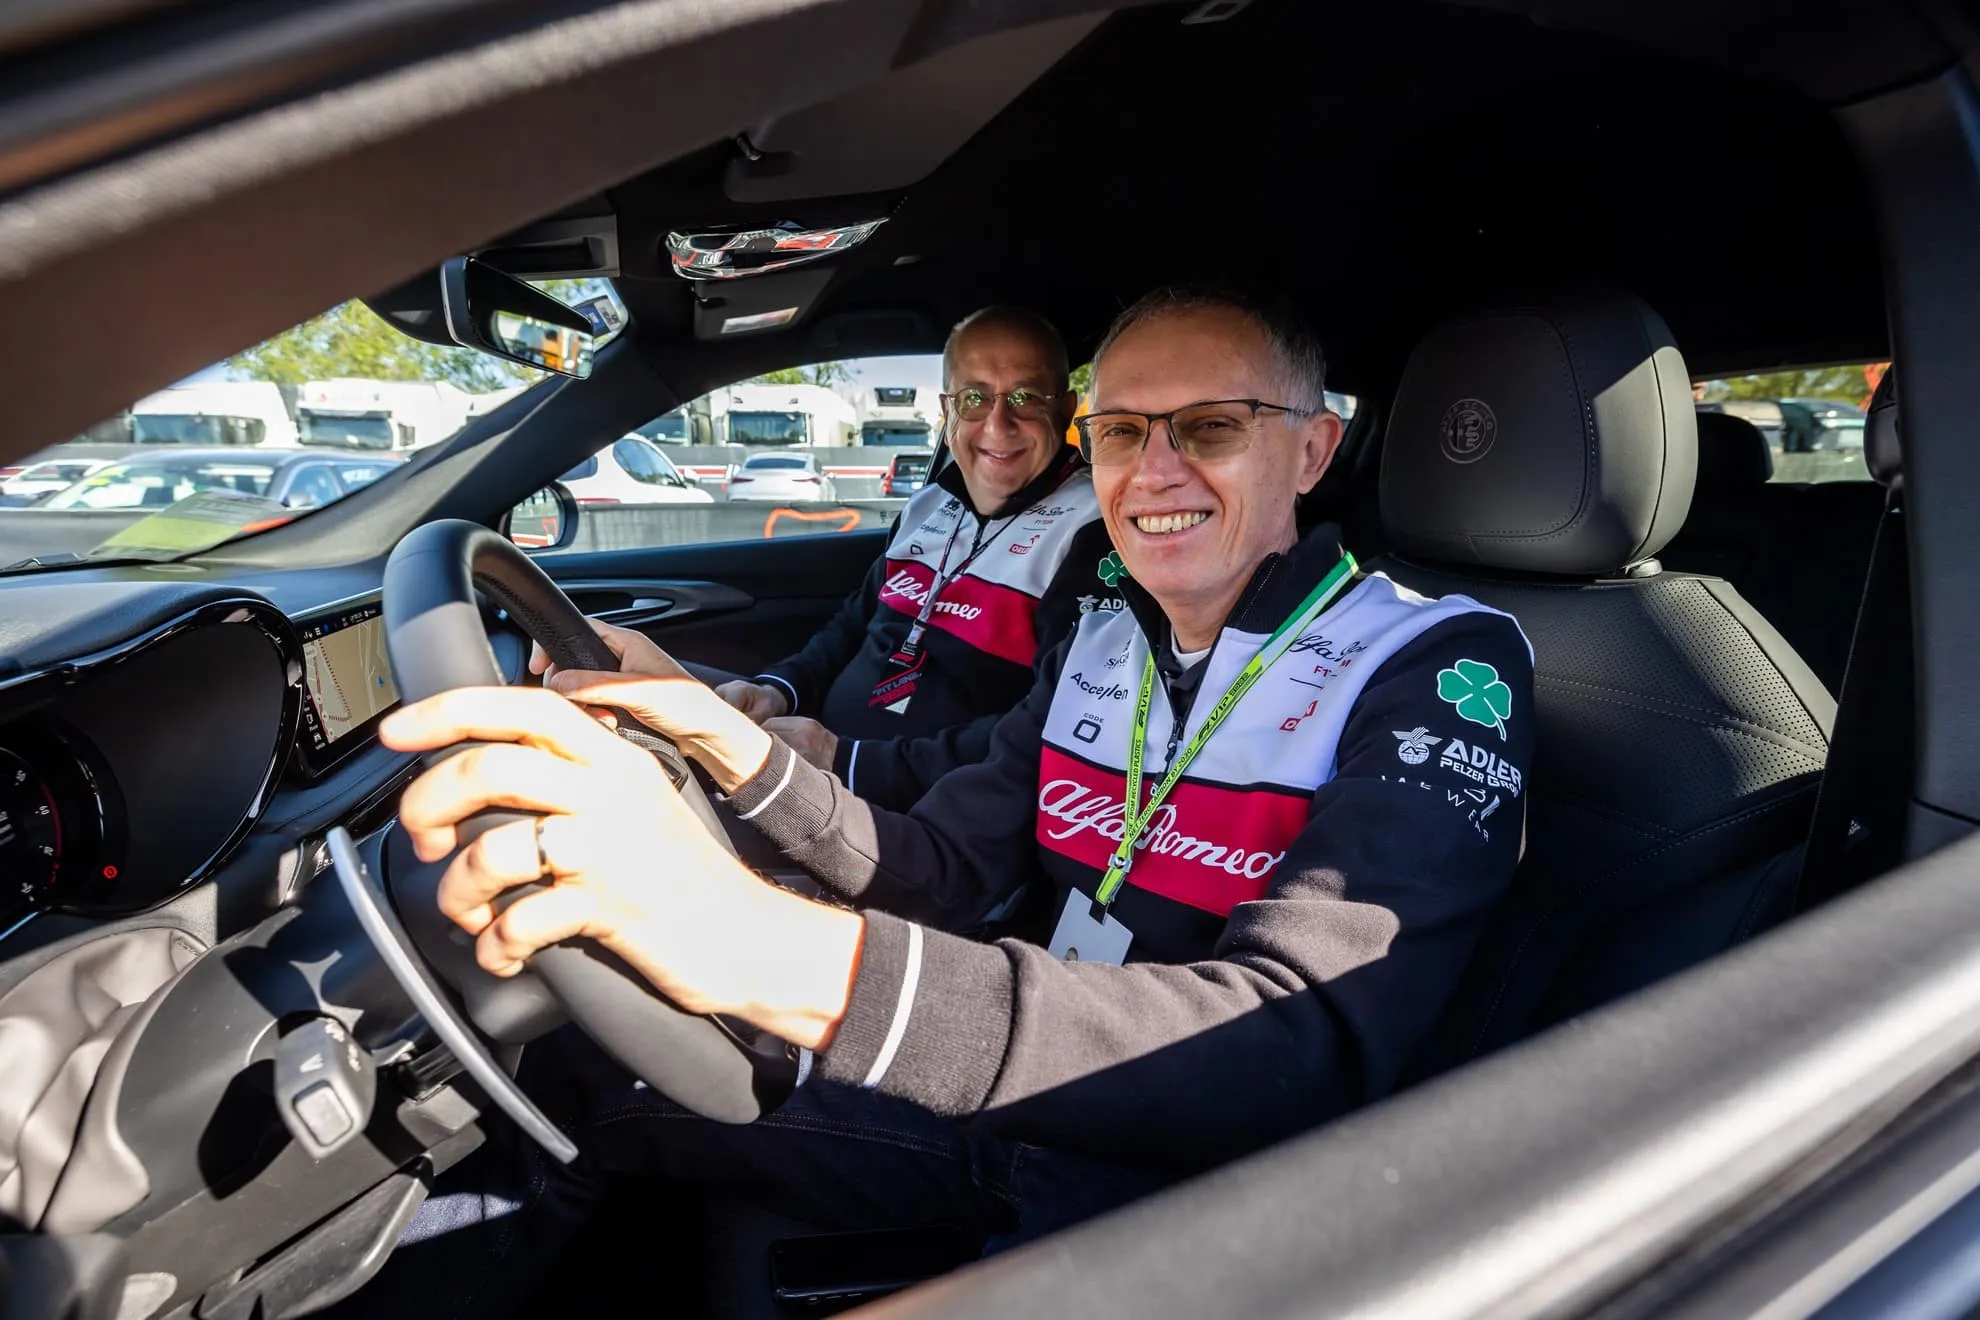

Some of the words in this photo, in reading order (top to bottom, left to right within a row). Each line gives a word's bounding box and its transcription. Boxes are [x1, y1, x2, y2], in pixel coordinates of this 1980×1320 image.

[1099, 598, 1129, 610] ADL
[1133, 739, 1142, 768] PLASTICS
[1440, 756, 1485, 784] PELZER
[1441, 737, 1522, 791] ADLER
[1139, 804, 1154, 825] ZERO
[1150, 776, 1172, 805] CARBON
[1170, 766, 1180, 778] BY
[1179, 747, 1193, 768] 2030
[1038, 779, 1131, 842] Alfa
[1134, 803, 1287, 879] Romeo
